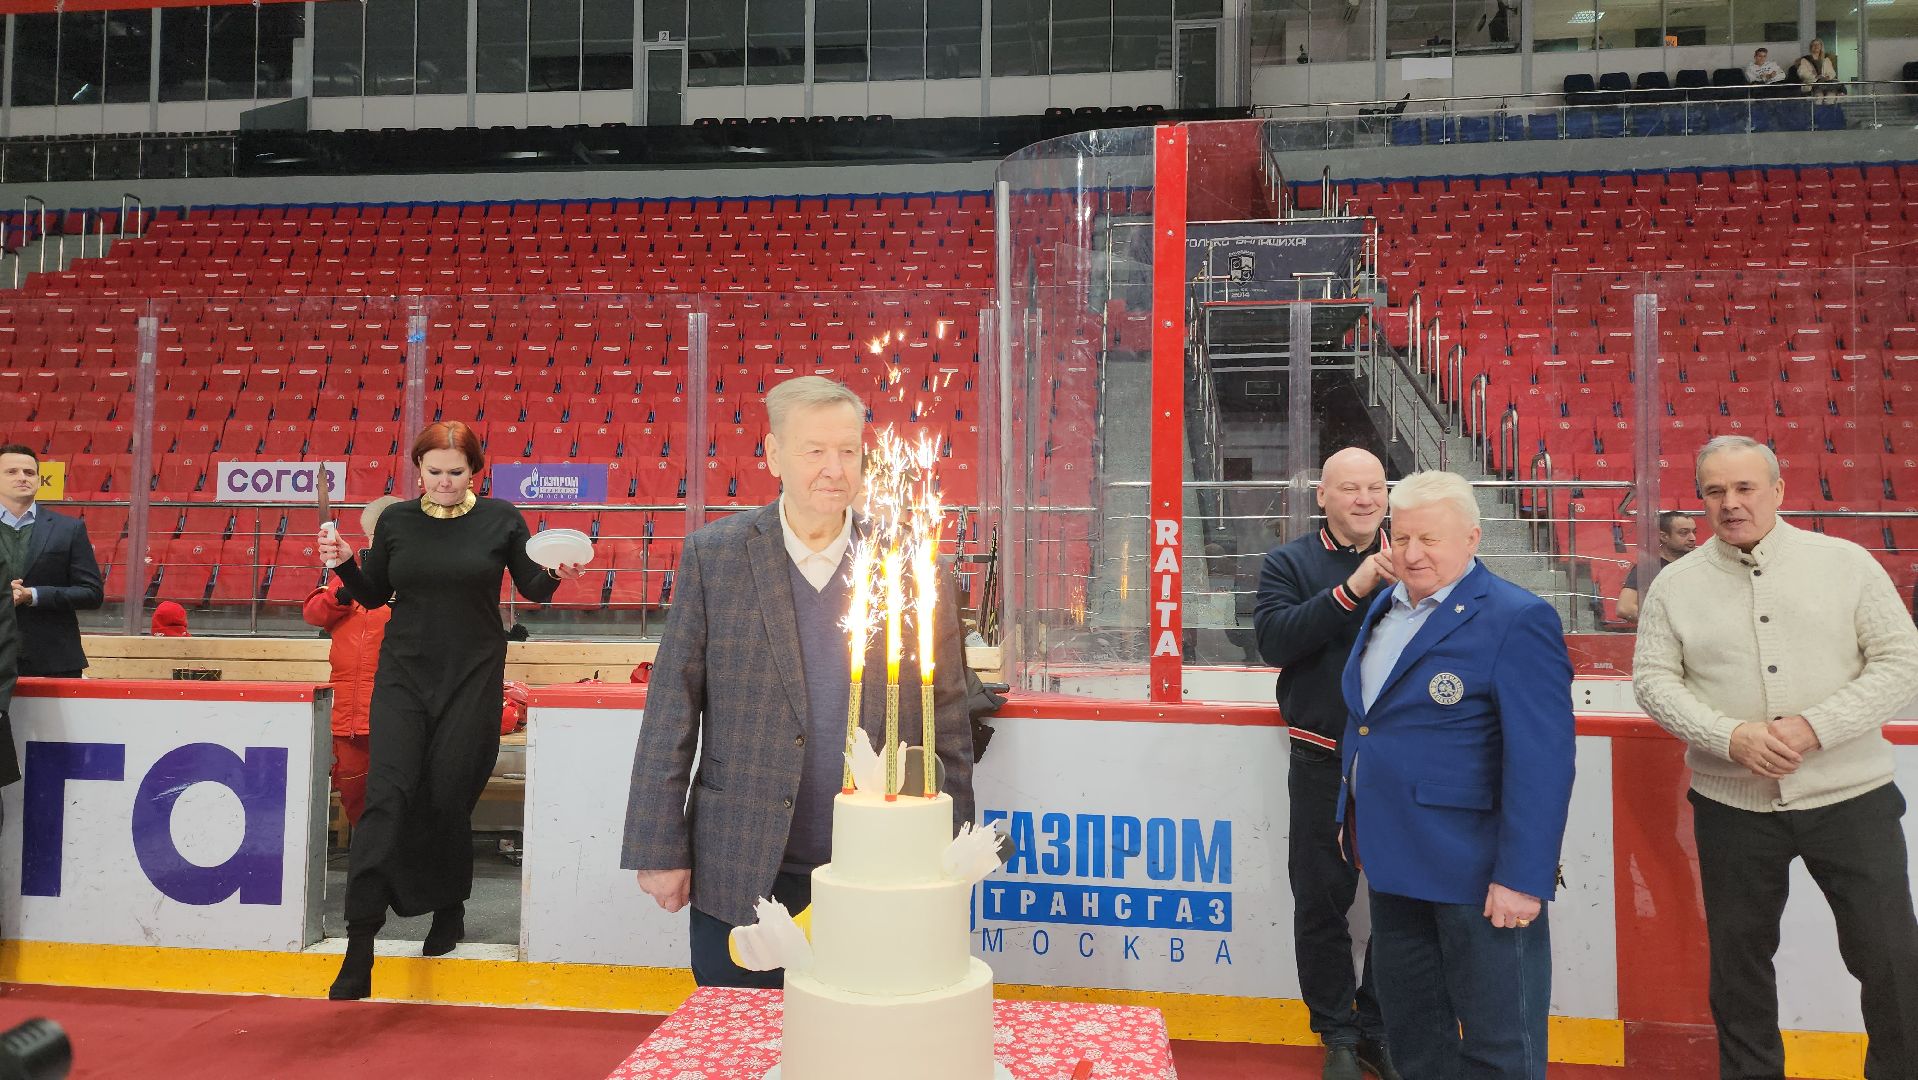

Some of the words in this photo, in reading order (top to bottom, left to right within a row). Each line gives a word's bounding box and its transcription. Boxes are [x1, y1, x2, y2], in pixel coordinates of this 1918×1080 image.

[540, 476, 579, 487] ГАЗПРОМ
[1153, 519, 1181, 657] RAITA
[990, 888, 1226, 925] ТРАНСГАЗ
[982, 928, 1233, 965] МОСКВА
